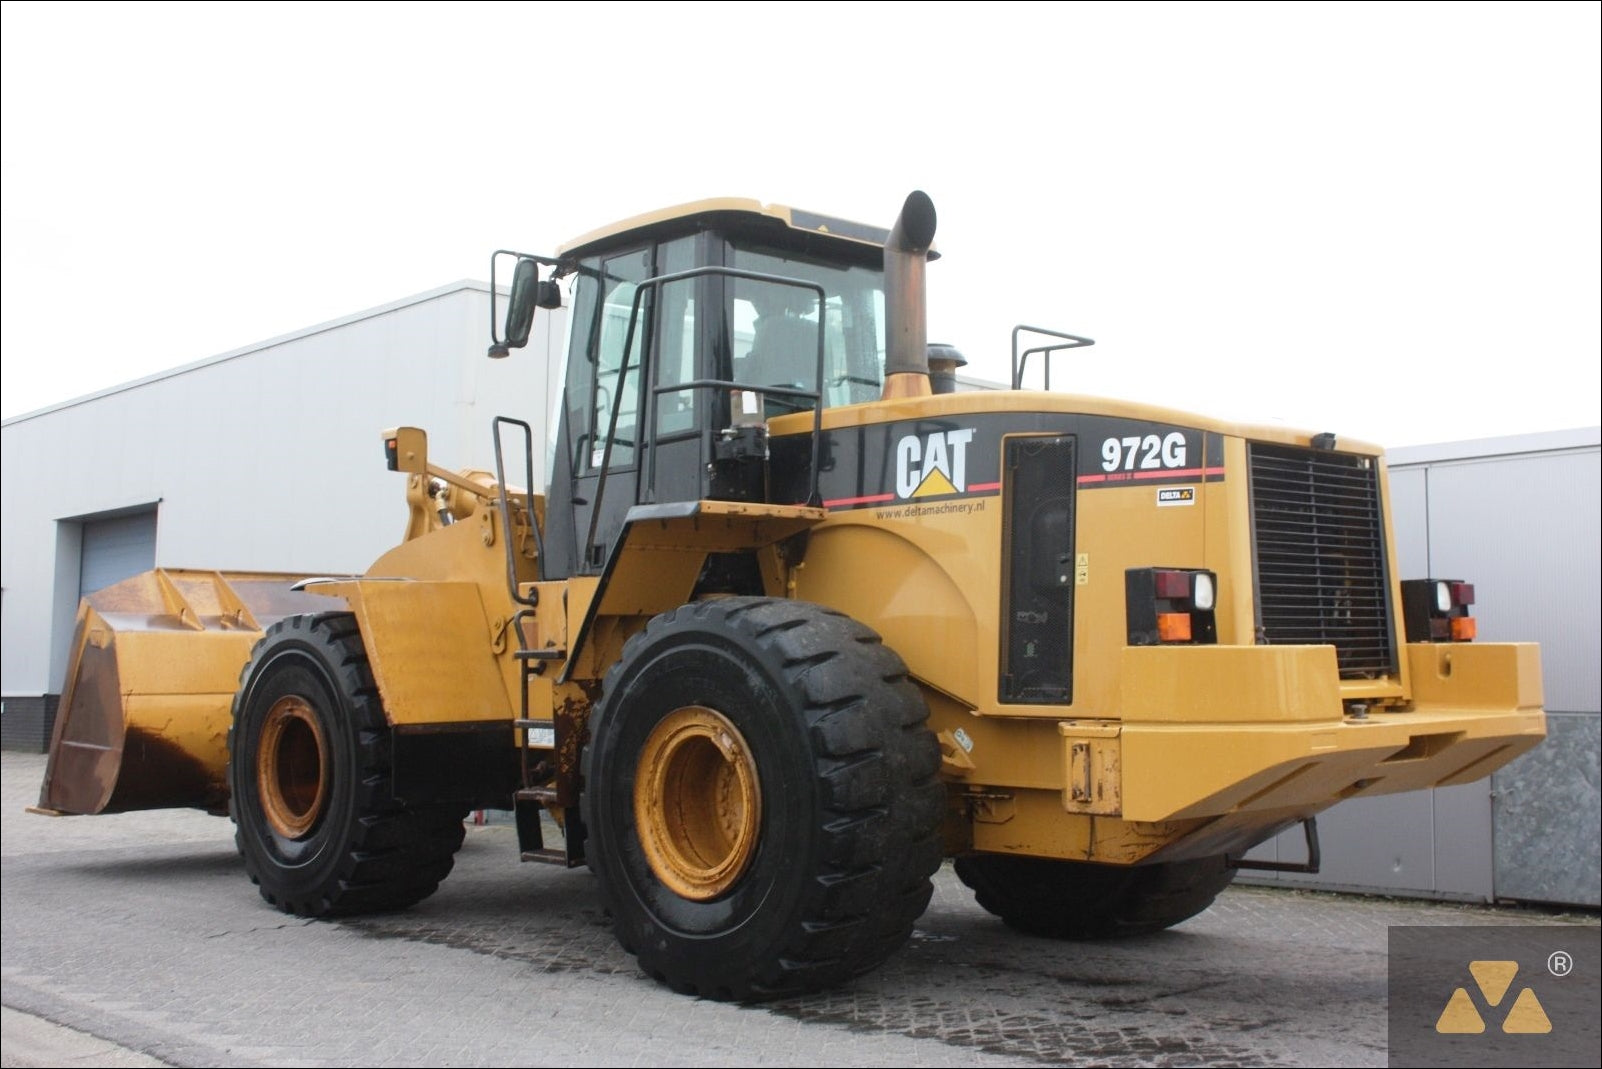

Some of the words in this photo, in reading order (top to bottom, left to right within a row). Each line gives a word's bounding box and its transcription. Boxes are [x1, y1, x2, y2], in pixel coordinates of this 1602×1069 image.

[896, 428, 973, 499] CAT
[1101, 432, 1187, 472] 972G
[876, 500, 985, 519] www.deltamachinery.nl
[1160, 491, 1181, 500] DELTA
